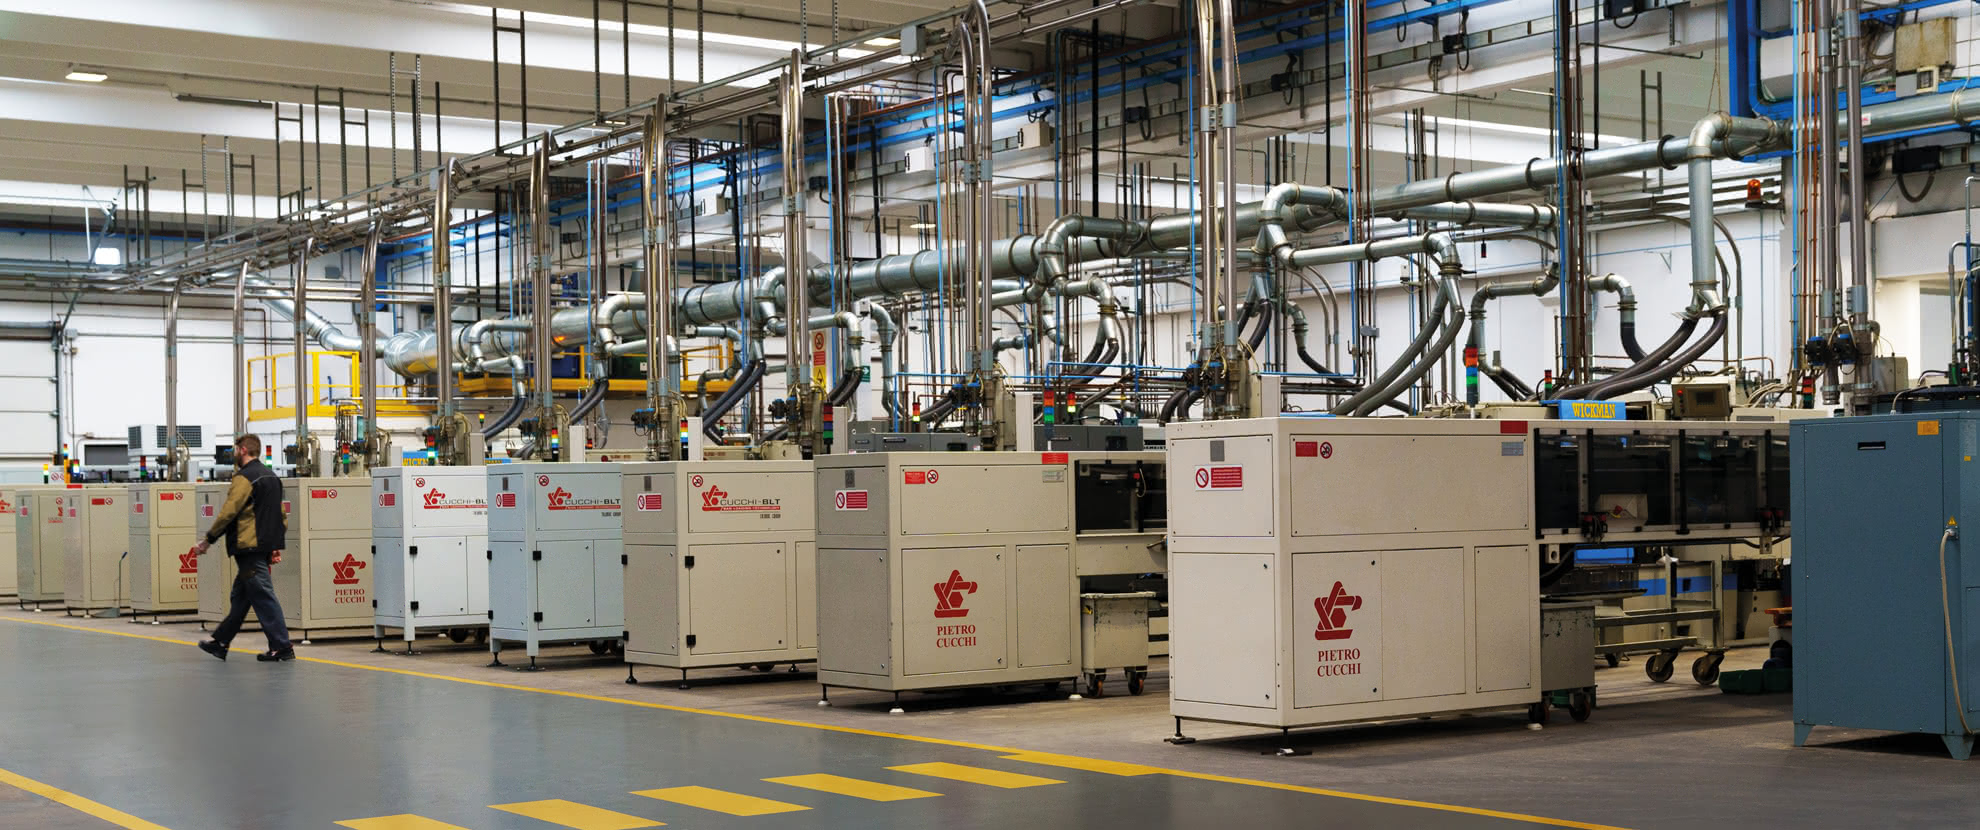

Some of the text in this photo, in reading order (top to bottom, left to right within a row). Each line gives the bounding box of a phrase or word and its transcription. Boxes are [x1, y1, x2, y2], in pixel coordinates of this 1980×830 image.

[1572, 402, 1616, 418] WICKMAN
[334, 596, 365, 604] CUCCHI
[936, 624, 976, 636] PIETRO
[936, 636, 977, 648] CUCCHI
[1317, 648, 1361, 662] PIETRO
[1316, 663, 1361, 677] CUCCHI
